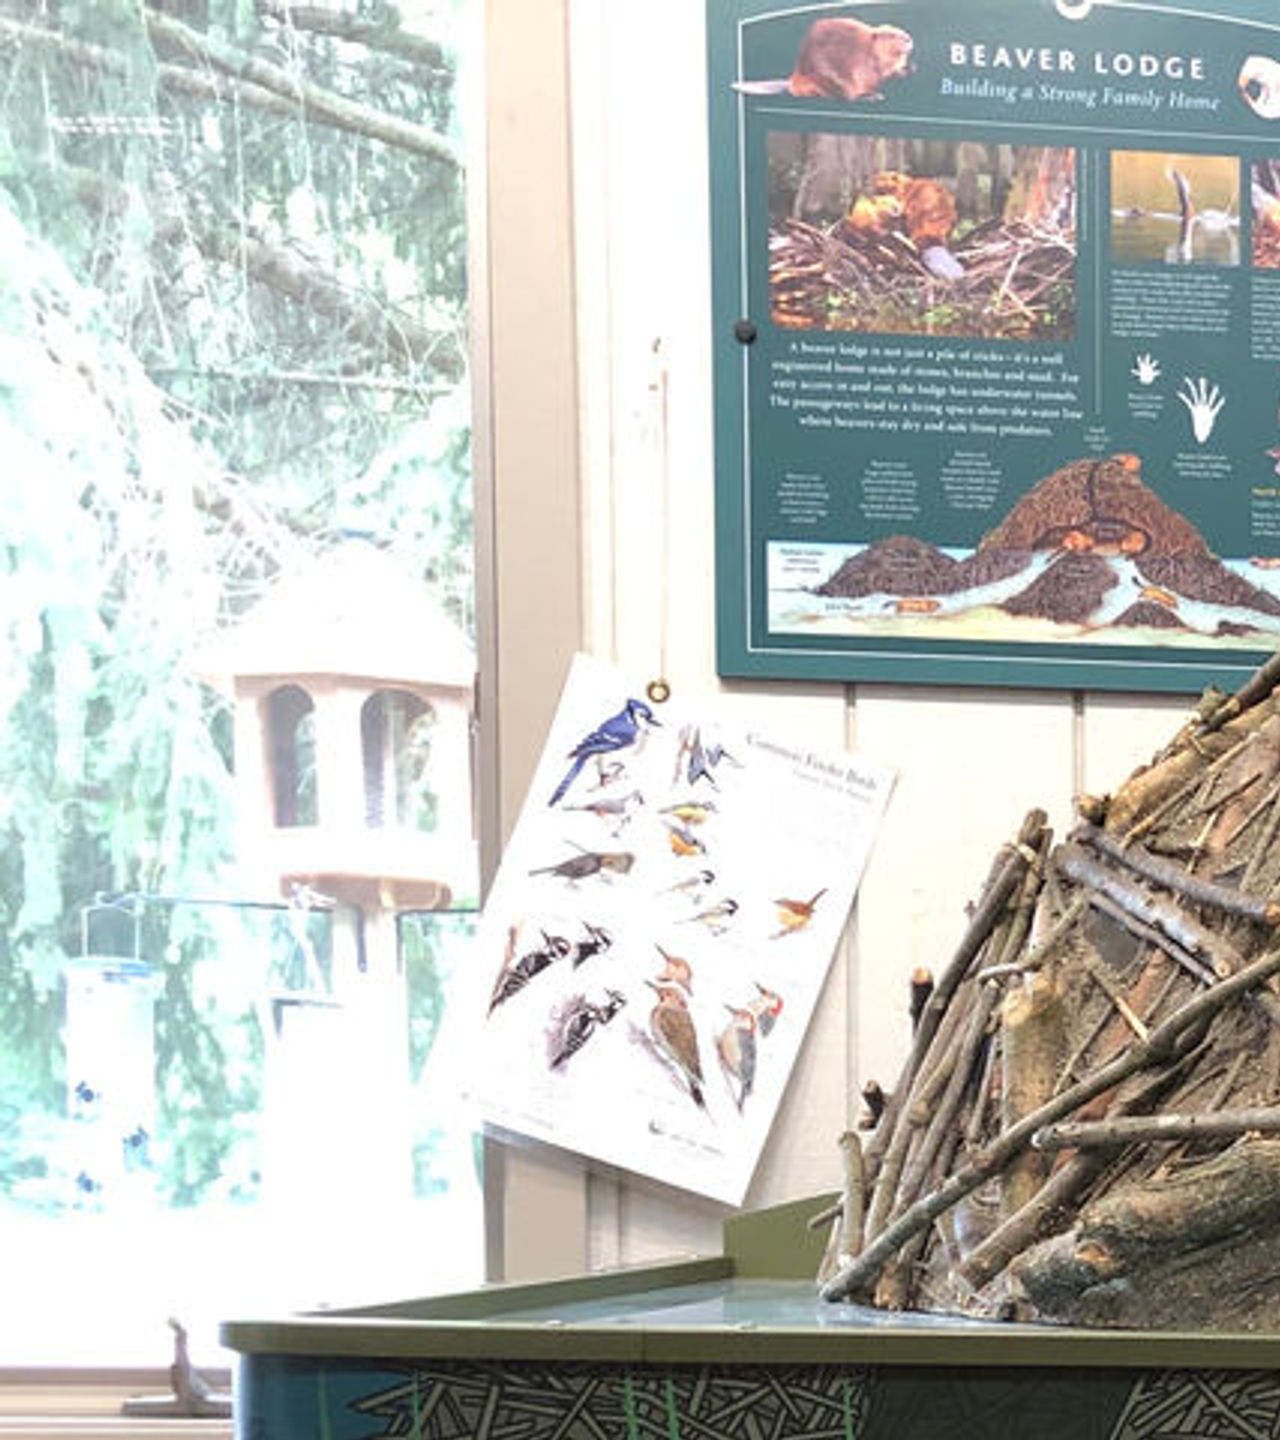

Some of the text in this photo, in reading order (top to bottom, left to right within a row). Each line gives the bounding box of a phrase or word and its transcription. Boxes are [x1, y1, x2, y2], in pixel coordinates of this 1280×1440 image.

[950, 42, 1205, 80] BEAVER LODGE
[940, 78, 1221, 112] Building a Strong Family Home
